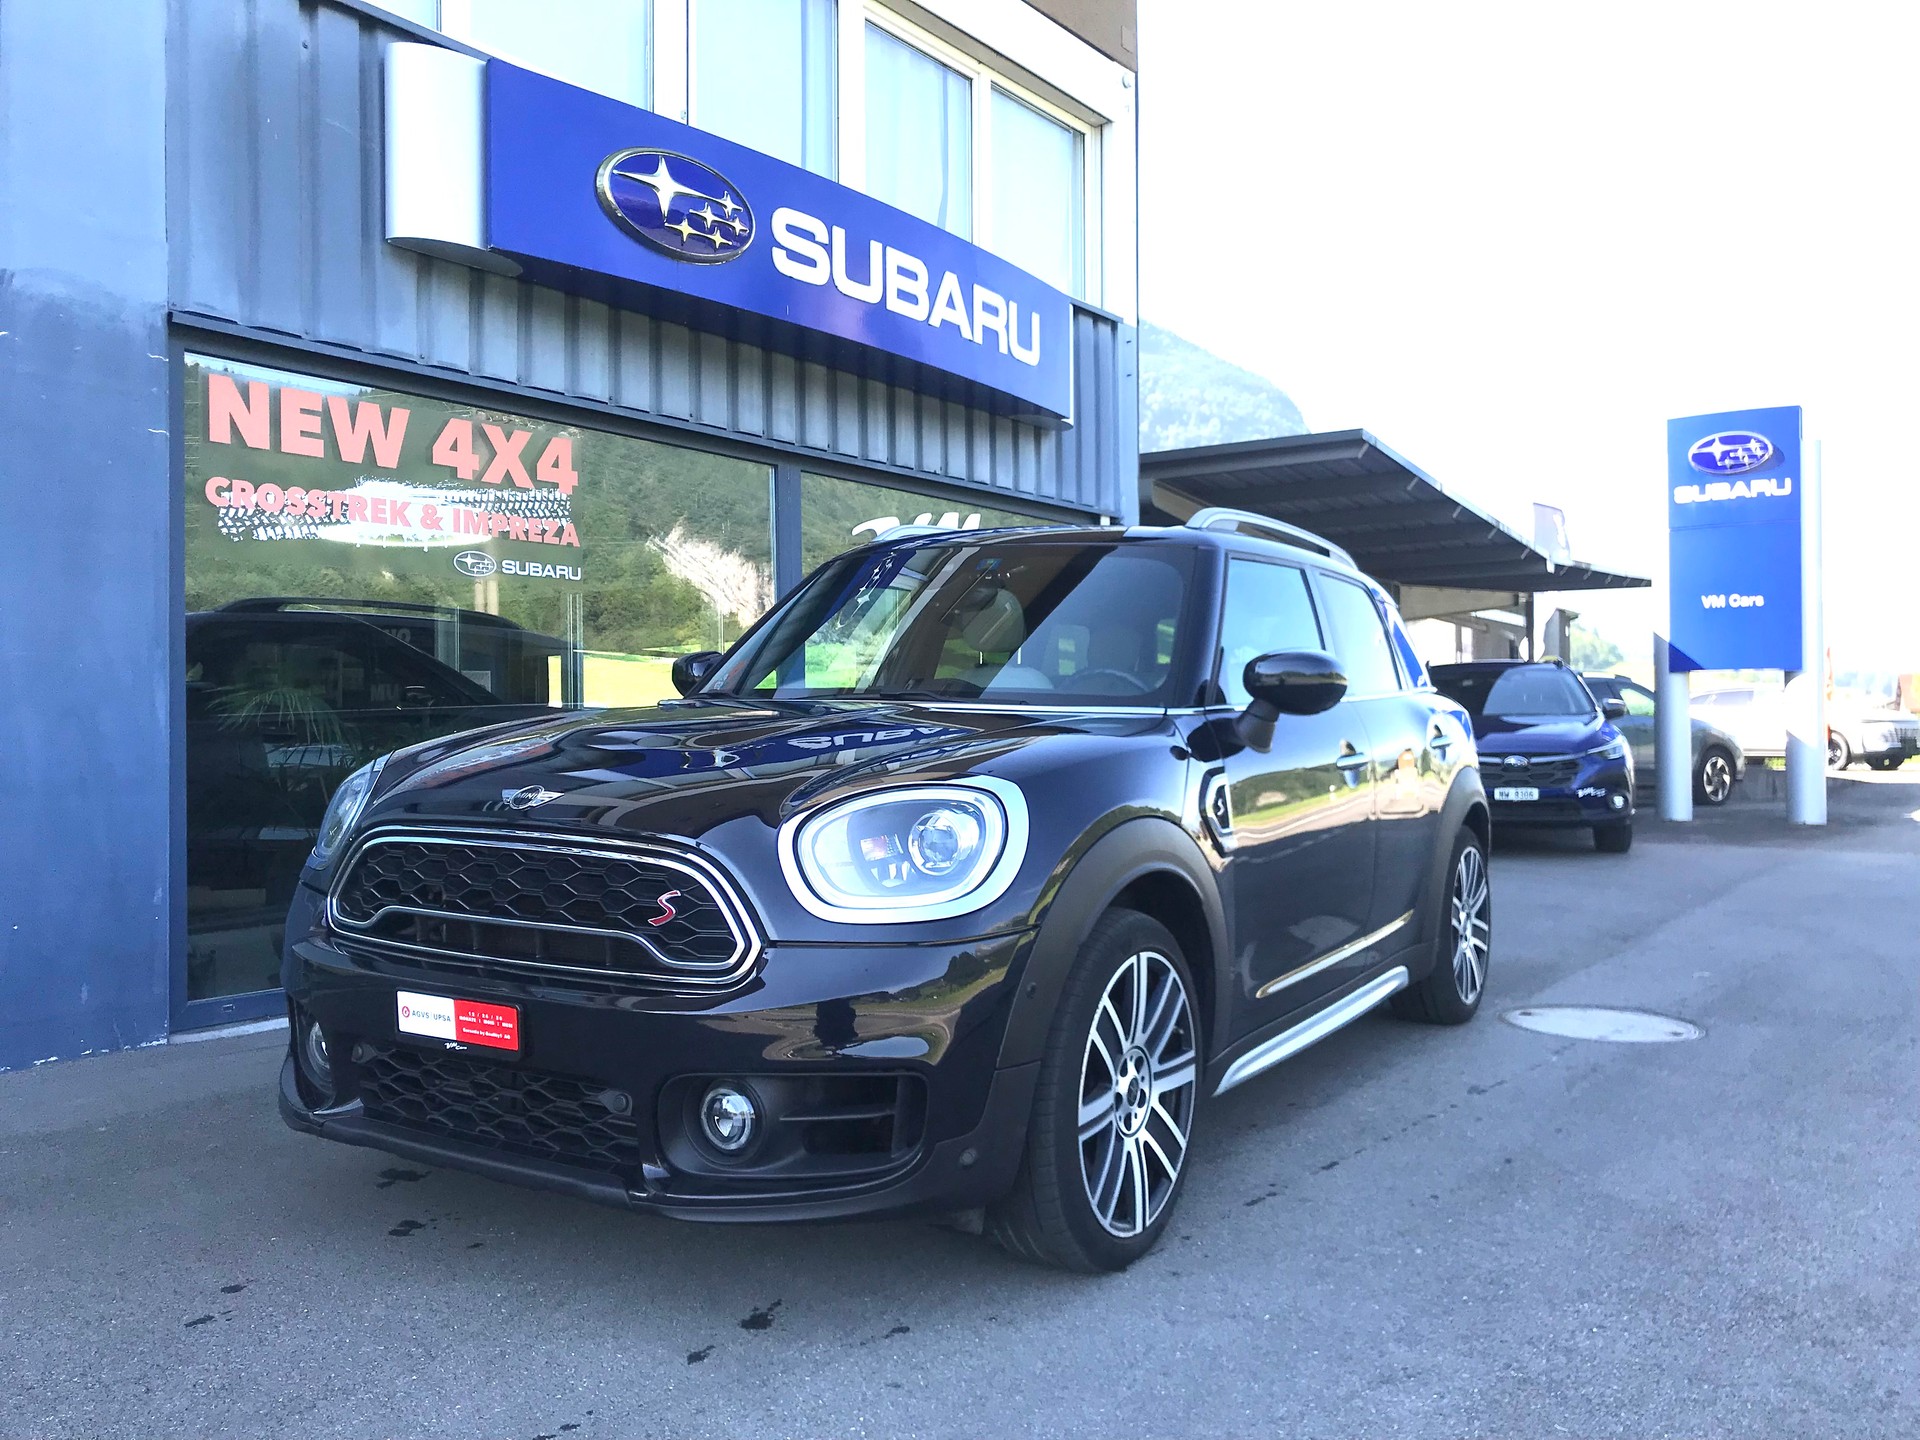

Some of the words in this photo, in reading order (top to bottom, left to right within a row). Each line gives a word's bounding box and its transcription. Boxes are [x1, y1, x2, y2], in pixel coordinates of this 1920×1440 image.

[770, 206, 1042, 368] SUBARU
[207, 373, 411, 470] NEW
[432, 416, 579, 496] 4X4
[1673, 477, 1793, 504] SUBARU
[204, 476, 411, 527] CROSSTREK
[420, 503, 444, 531] &
[452, 506, 581, 548] IMPREZA
[500, 559, 582, 581] SUBARU
[1701, 594, 1726, 609] VM
[1728, 593, 1765, 608] Cars
[647, 889, 682, 927] S
[411, 1010, 430, 1019] AGVS
[433, 1013, 452, 1022] UPSA
